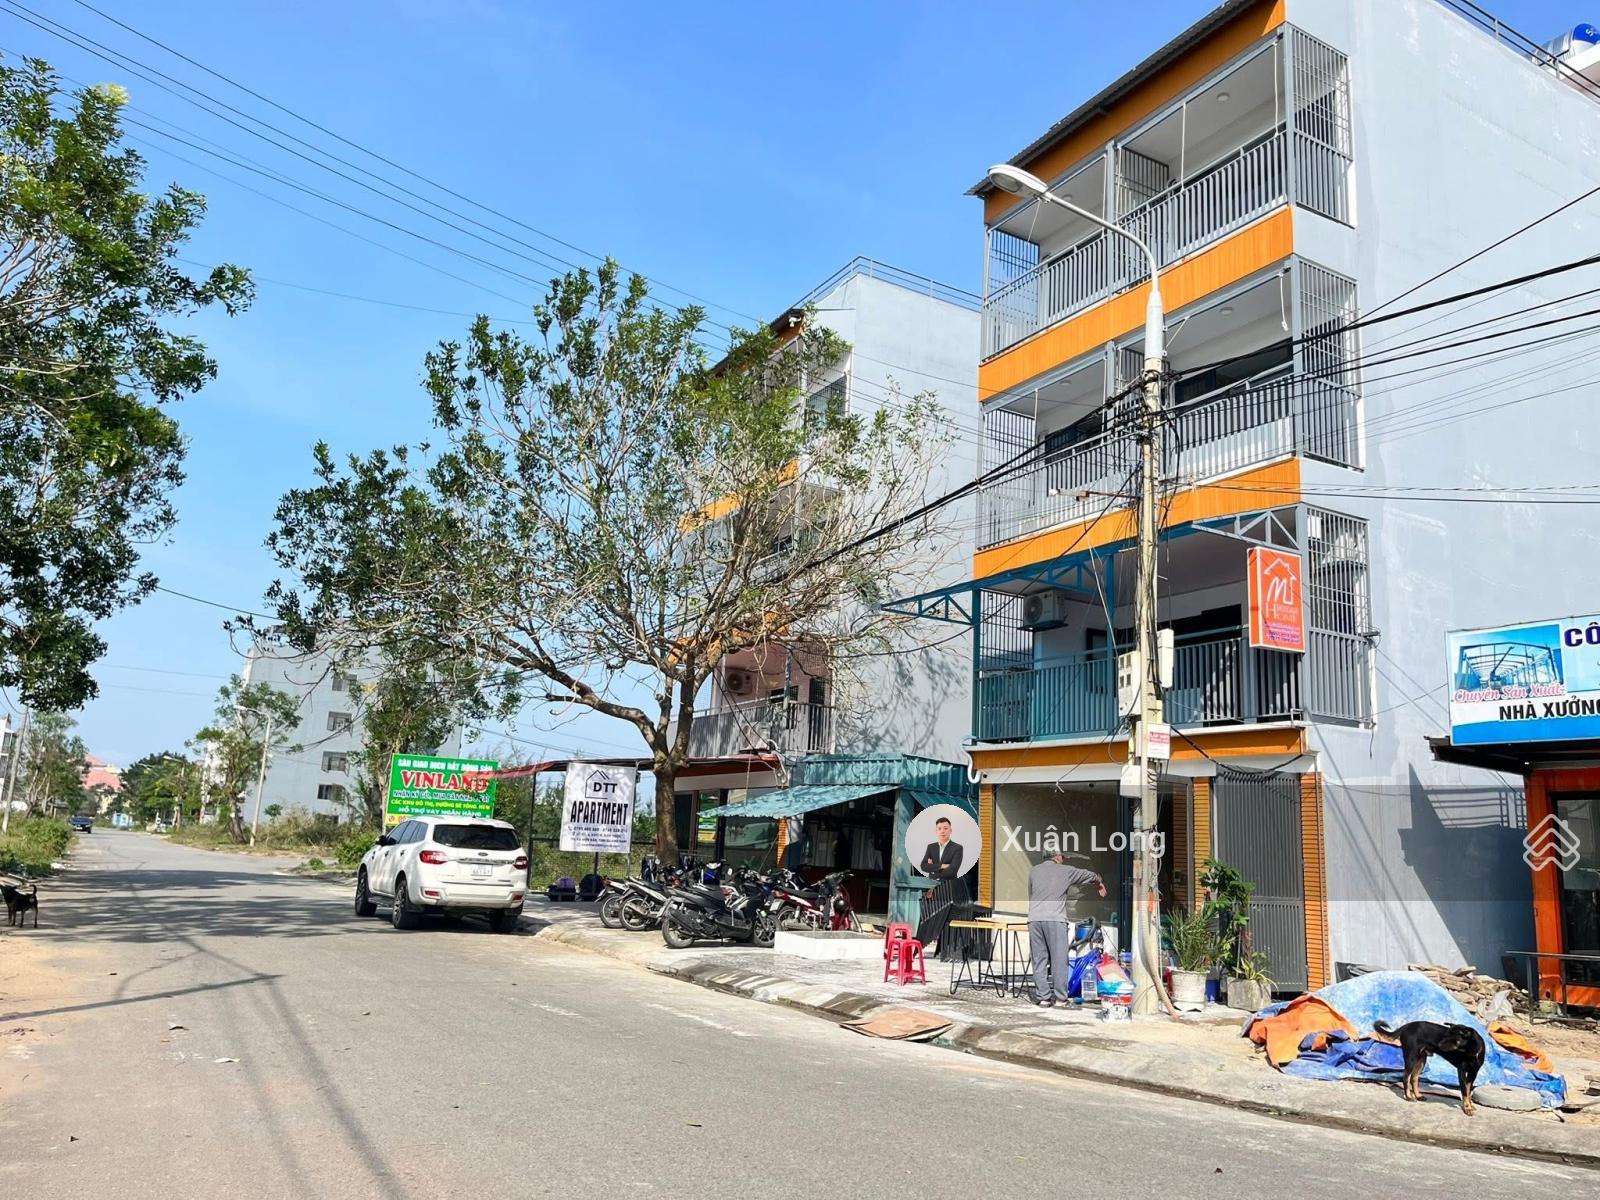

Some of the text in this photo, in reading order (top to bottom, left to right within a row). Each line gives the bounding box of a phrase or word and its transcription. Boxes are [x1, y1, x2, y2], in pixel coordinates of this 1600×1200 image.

[1564, 621, 1600, 647] CÔ
[1500, 701, 1537, 720] NHÀ
[593, 782, 617, 793] DTT
[426, 807, 440, 815] VAY
[570, 800, 629, 825] APARTMENT
